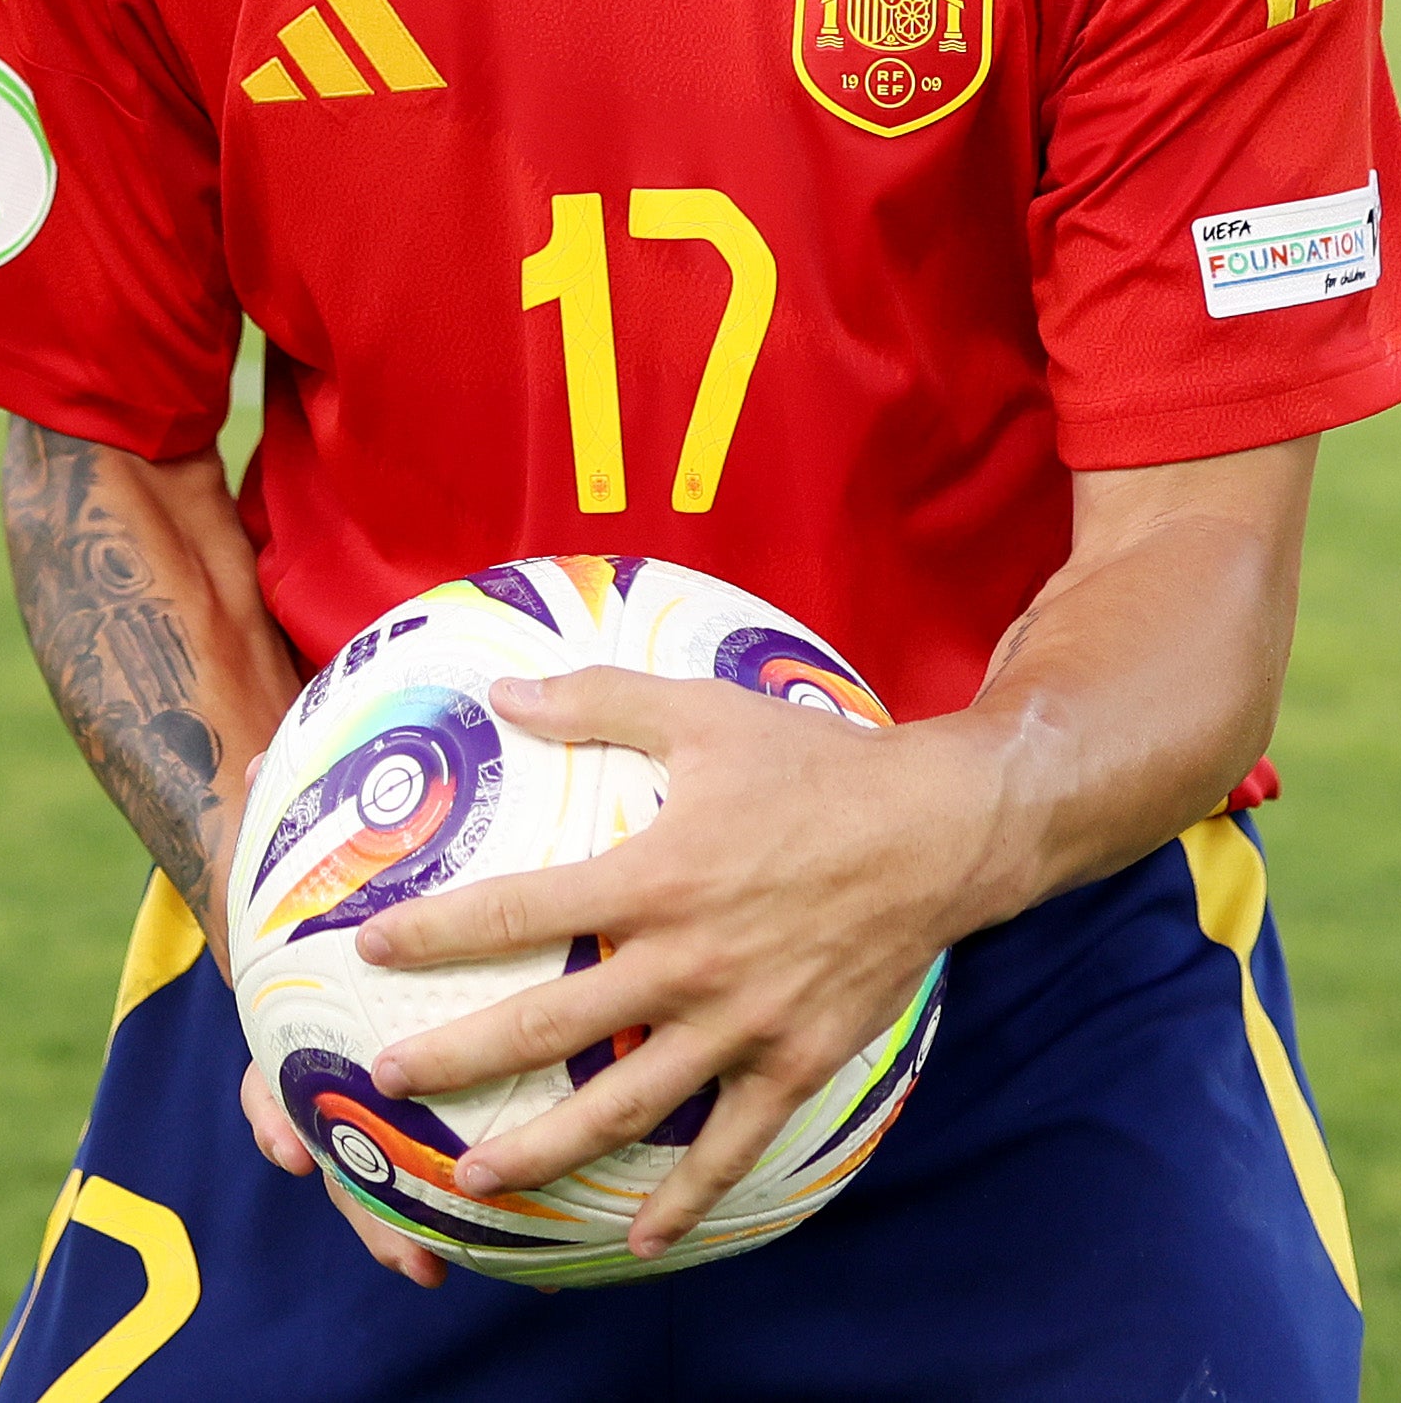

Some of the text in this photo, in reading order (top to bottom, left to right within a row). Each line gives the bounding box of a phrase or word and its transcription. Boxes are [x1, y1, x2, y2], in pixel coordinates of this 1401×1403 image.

[841, 74, 860, 90] 19
[921, 76, 942, 92] 09
[1202, 220, 1252, 242] UEFA
[1208, 228, 1365, 279] FOUNDATION
[1324, 272, 1338, 295] for
[521, 188, 777, 514] 17
